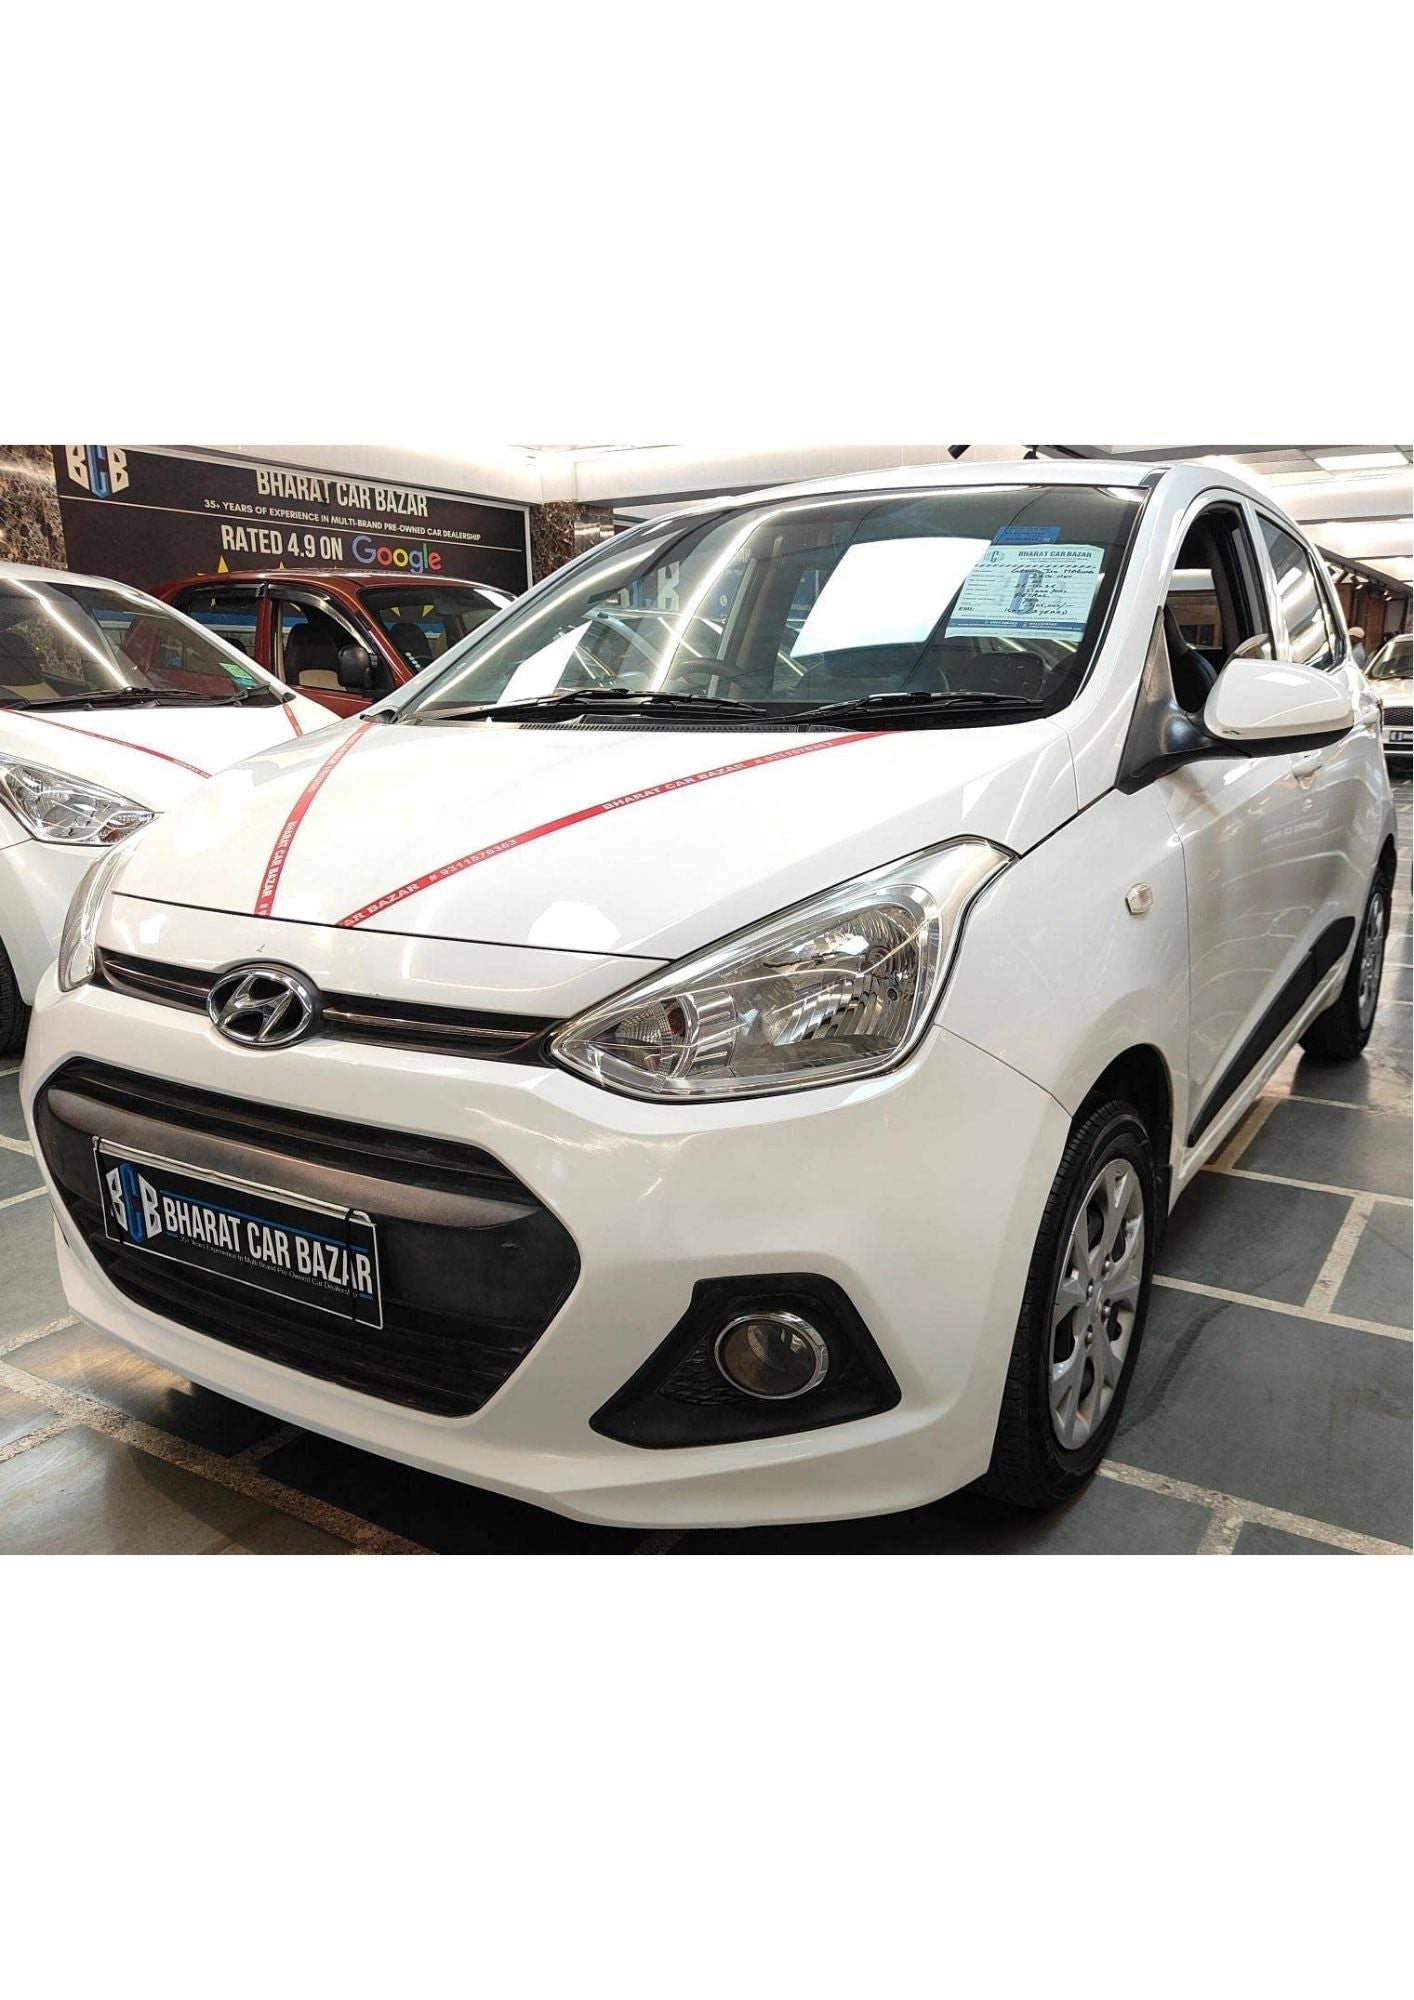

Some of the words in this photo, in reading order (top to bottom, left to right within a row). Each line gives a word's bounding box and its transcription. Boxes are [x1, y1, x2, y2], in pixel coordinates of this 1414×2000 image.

[256, 469, 331, 504] BHARAT
[336, 482, 372, 510] CAR
[374, 487, 428, 517] BAZAR
[204, 499, 220, 509] 35+
[222, 502, 253, 514] YEARS
[255, 507, 267, 515] OF
[269, 508, 319, 522] EXPERIENCE
[321, 515, 329, 523] IN
[331, 516, 382, 529] MULTI-BRAND
[384, 523, 425, 535] PRE-OWNED
[427, 528, 442, 537] CAR
[443, 530, 481, 541] DEALERSHIP
[221, 525, 283, 555] RATED
[287, 532, 316, 558] 4.9
[320, 536, 343, 560] ON
[352, 535, 442, 575] Google
[1066, 551, 1092, 559] BAZAR
[602, 787, 662, 811] BHARAT
[665, 776, 696, 790] CAR
[698, 762, 747, 780] BAZAR
[261, 867, 280, 898] BAZAR
[367, 882, 421, 914] BAZAR
[105, 1162, 163, 1242] BCB
[163, 1197, 241, 1253] BHARAT
[246, 1221, 291, 1269] CAR
[295, 1236, 374, 1294] BAZAR
